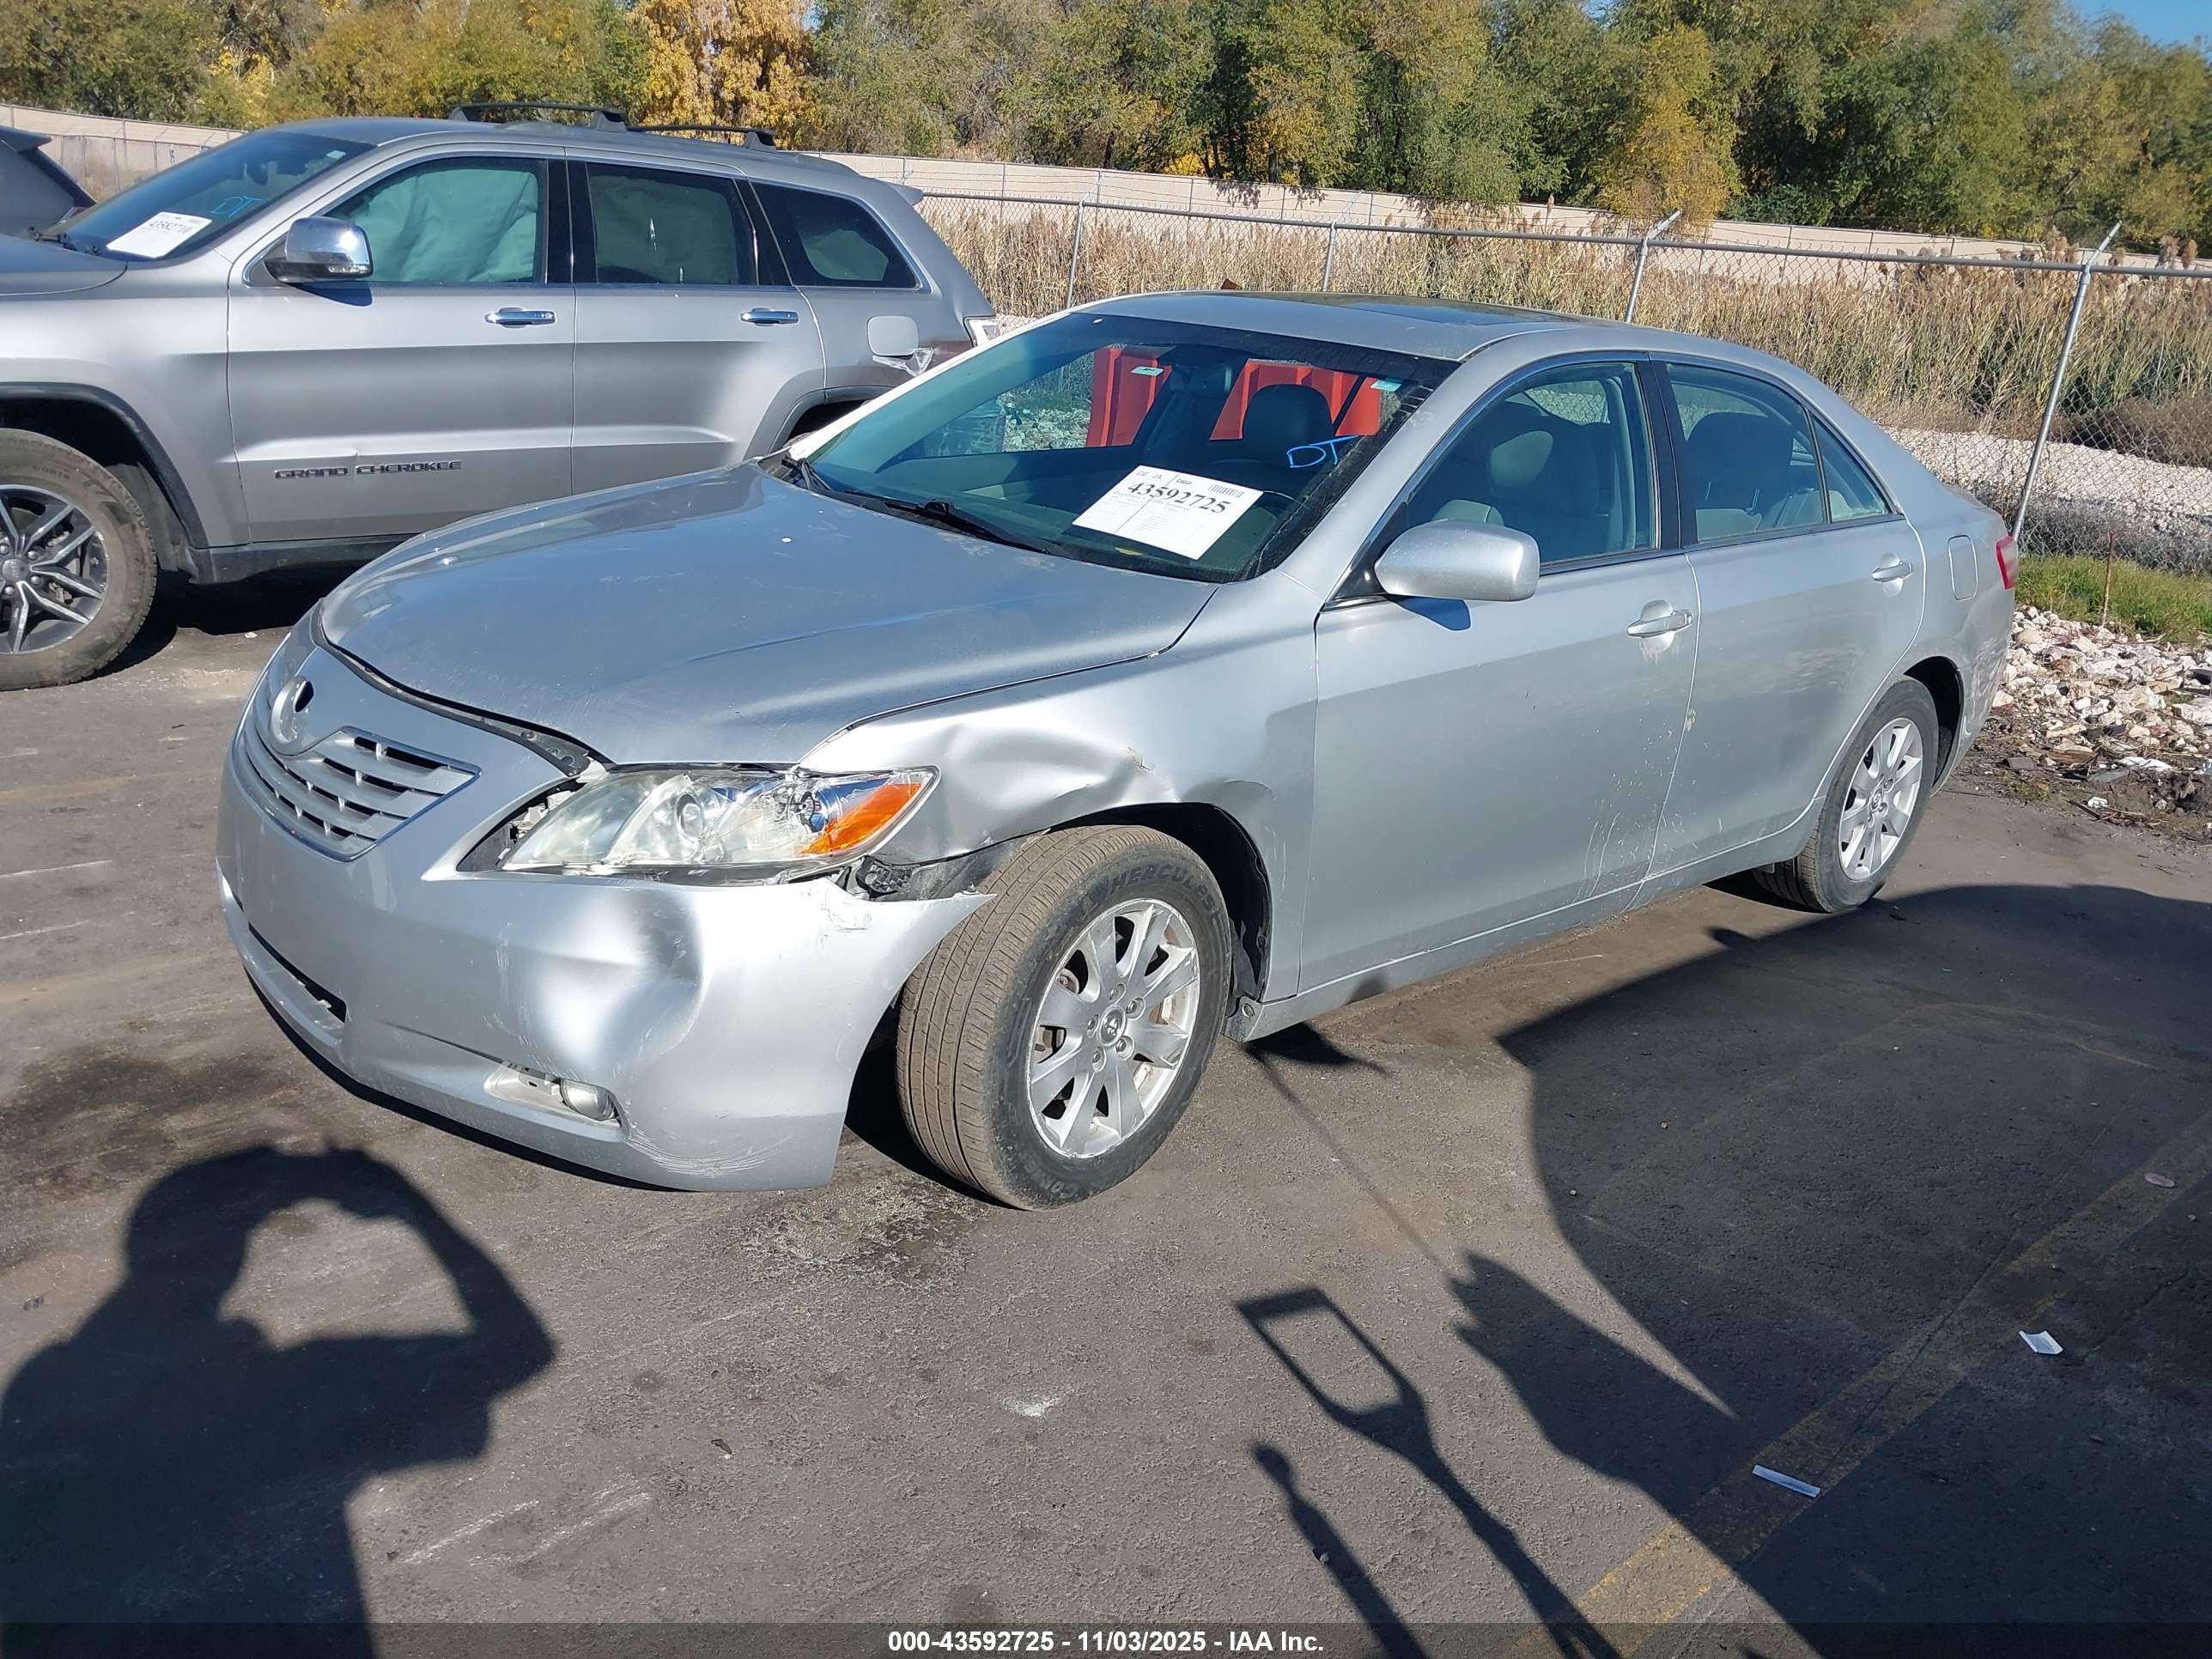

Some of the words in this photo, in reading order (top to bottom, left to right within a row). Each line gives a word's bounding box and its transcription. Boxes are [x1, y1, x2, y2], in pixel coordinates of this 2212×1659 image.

[1286, 435, 1359, 468] DT
[275, 467, 349, 480] GRAND
[356, 460, 462, 475] CHEROKEE
[1128, 483, 1231, 514] 43592725
[1109, 863, 1217, 911] HERCULES
